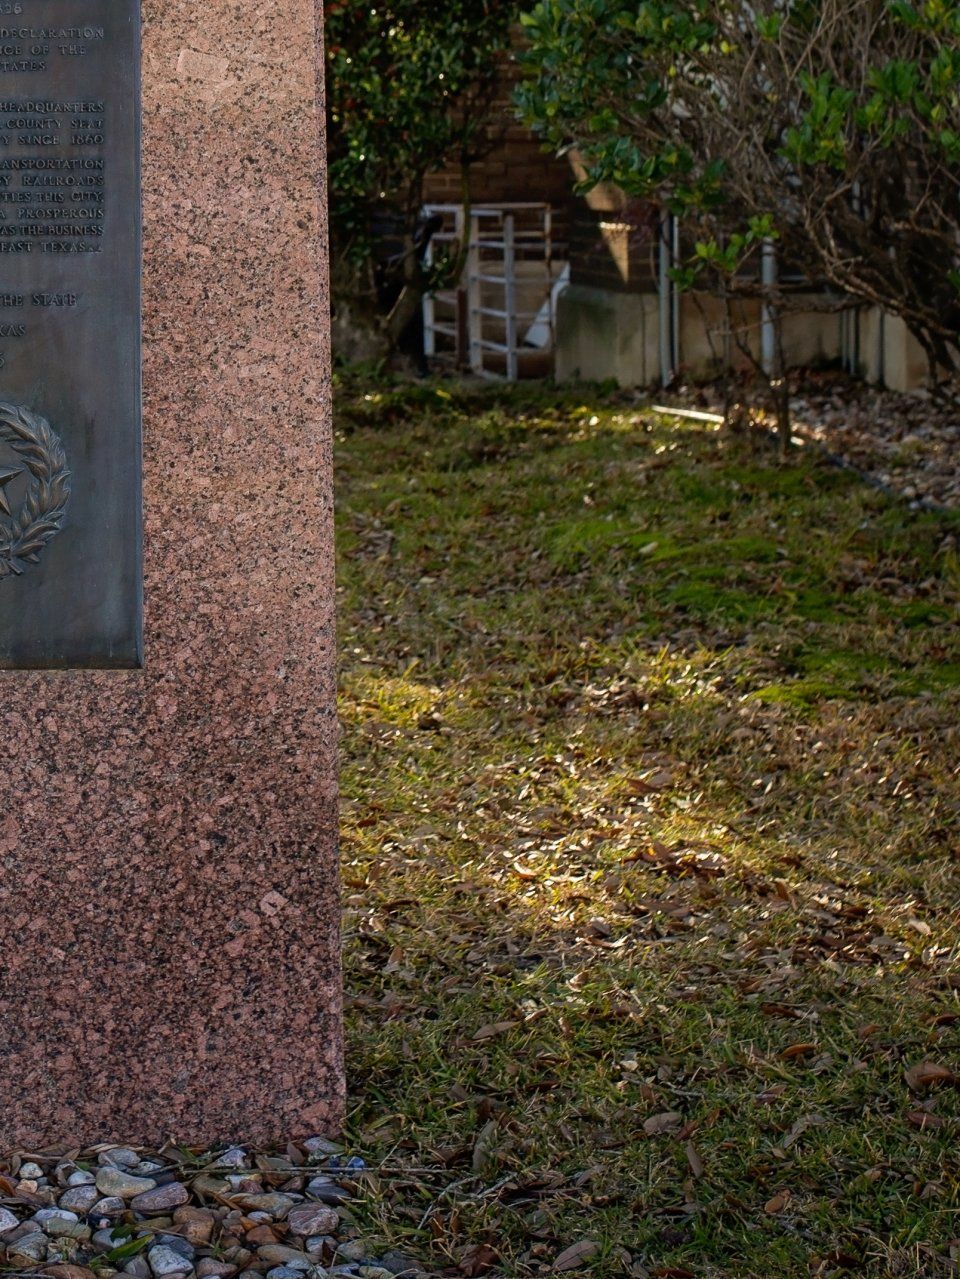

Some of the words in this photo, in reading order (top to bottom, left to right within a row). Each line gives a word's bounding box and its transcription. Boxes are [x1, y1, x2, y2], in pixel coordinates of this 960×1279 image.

[0, 27, 105, 39] DECLARATION
[30, 45, 50, 56] OF
[58, 45, 86, 56] THE
[0, 101, 104, 113] HEADQUARTERS
[6, 118, 63, 130] COUNTY
[71, 118, 104, 130] SEAT
[18, 134, 60, 145] SINCE
[70, 134, 104, 145] 1860
[22, 176, 104, 187] RAILROADS
[35, 192, 65, 203] THIS
[17, 209, 104, 220] PROSPEROUS
[19, 225, 46, 237] THE
[48, 225, 104, 237] BUSINESS
[31, 294, 79, 307] STATE
